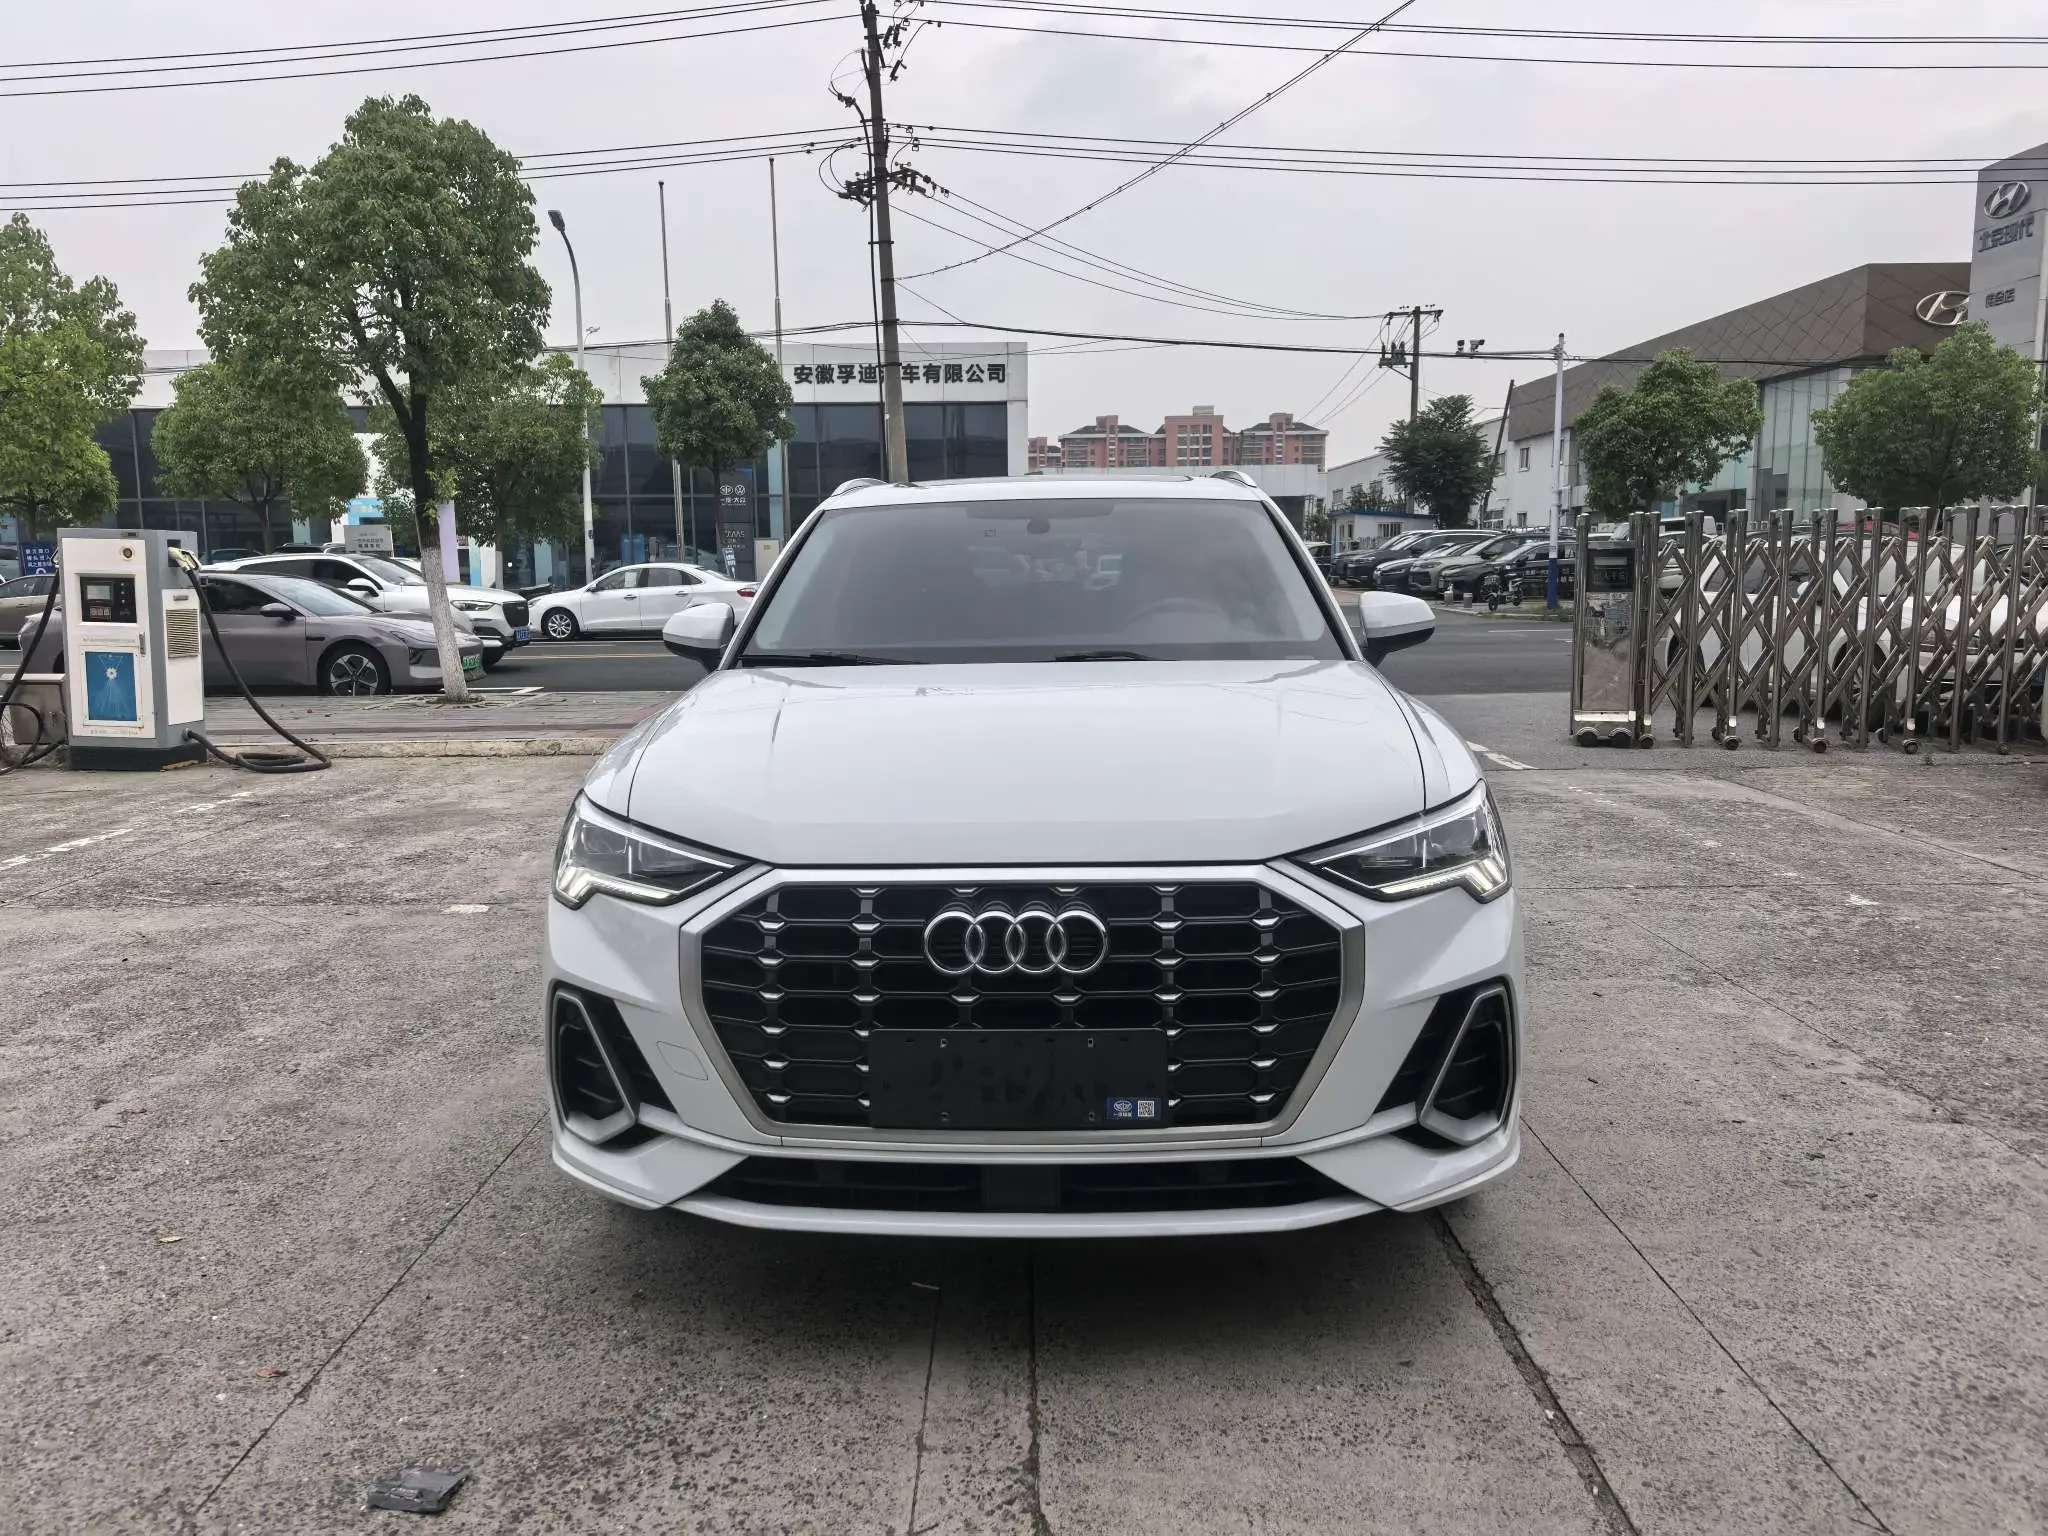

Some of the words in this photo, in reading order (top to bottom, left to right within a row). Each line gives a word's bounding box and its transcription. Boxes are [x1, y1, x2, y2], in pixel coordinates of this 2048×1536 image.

[793, 363, 1006, 384] 安徽孚迪车有限公司
